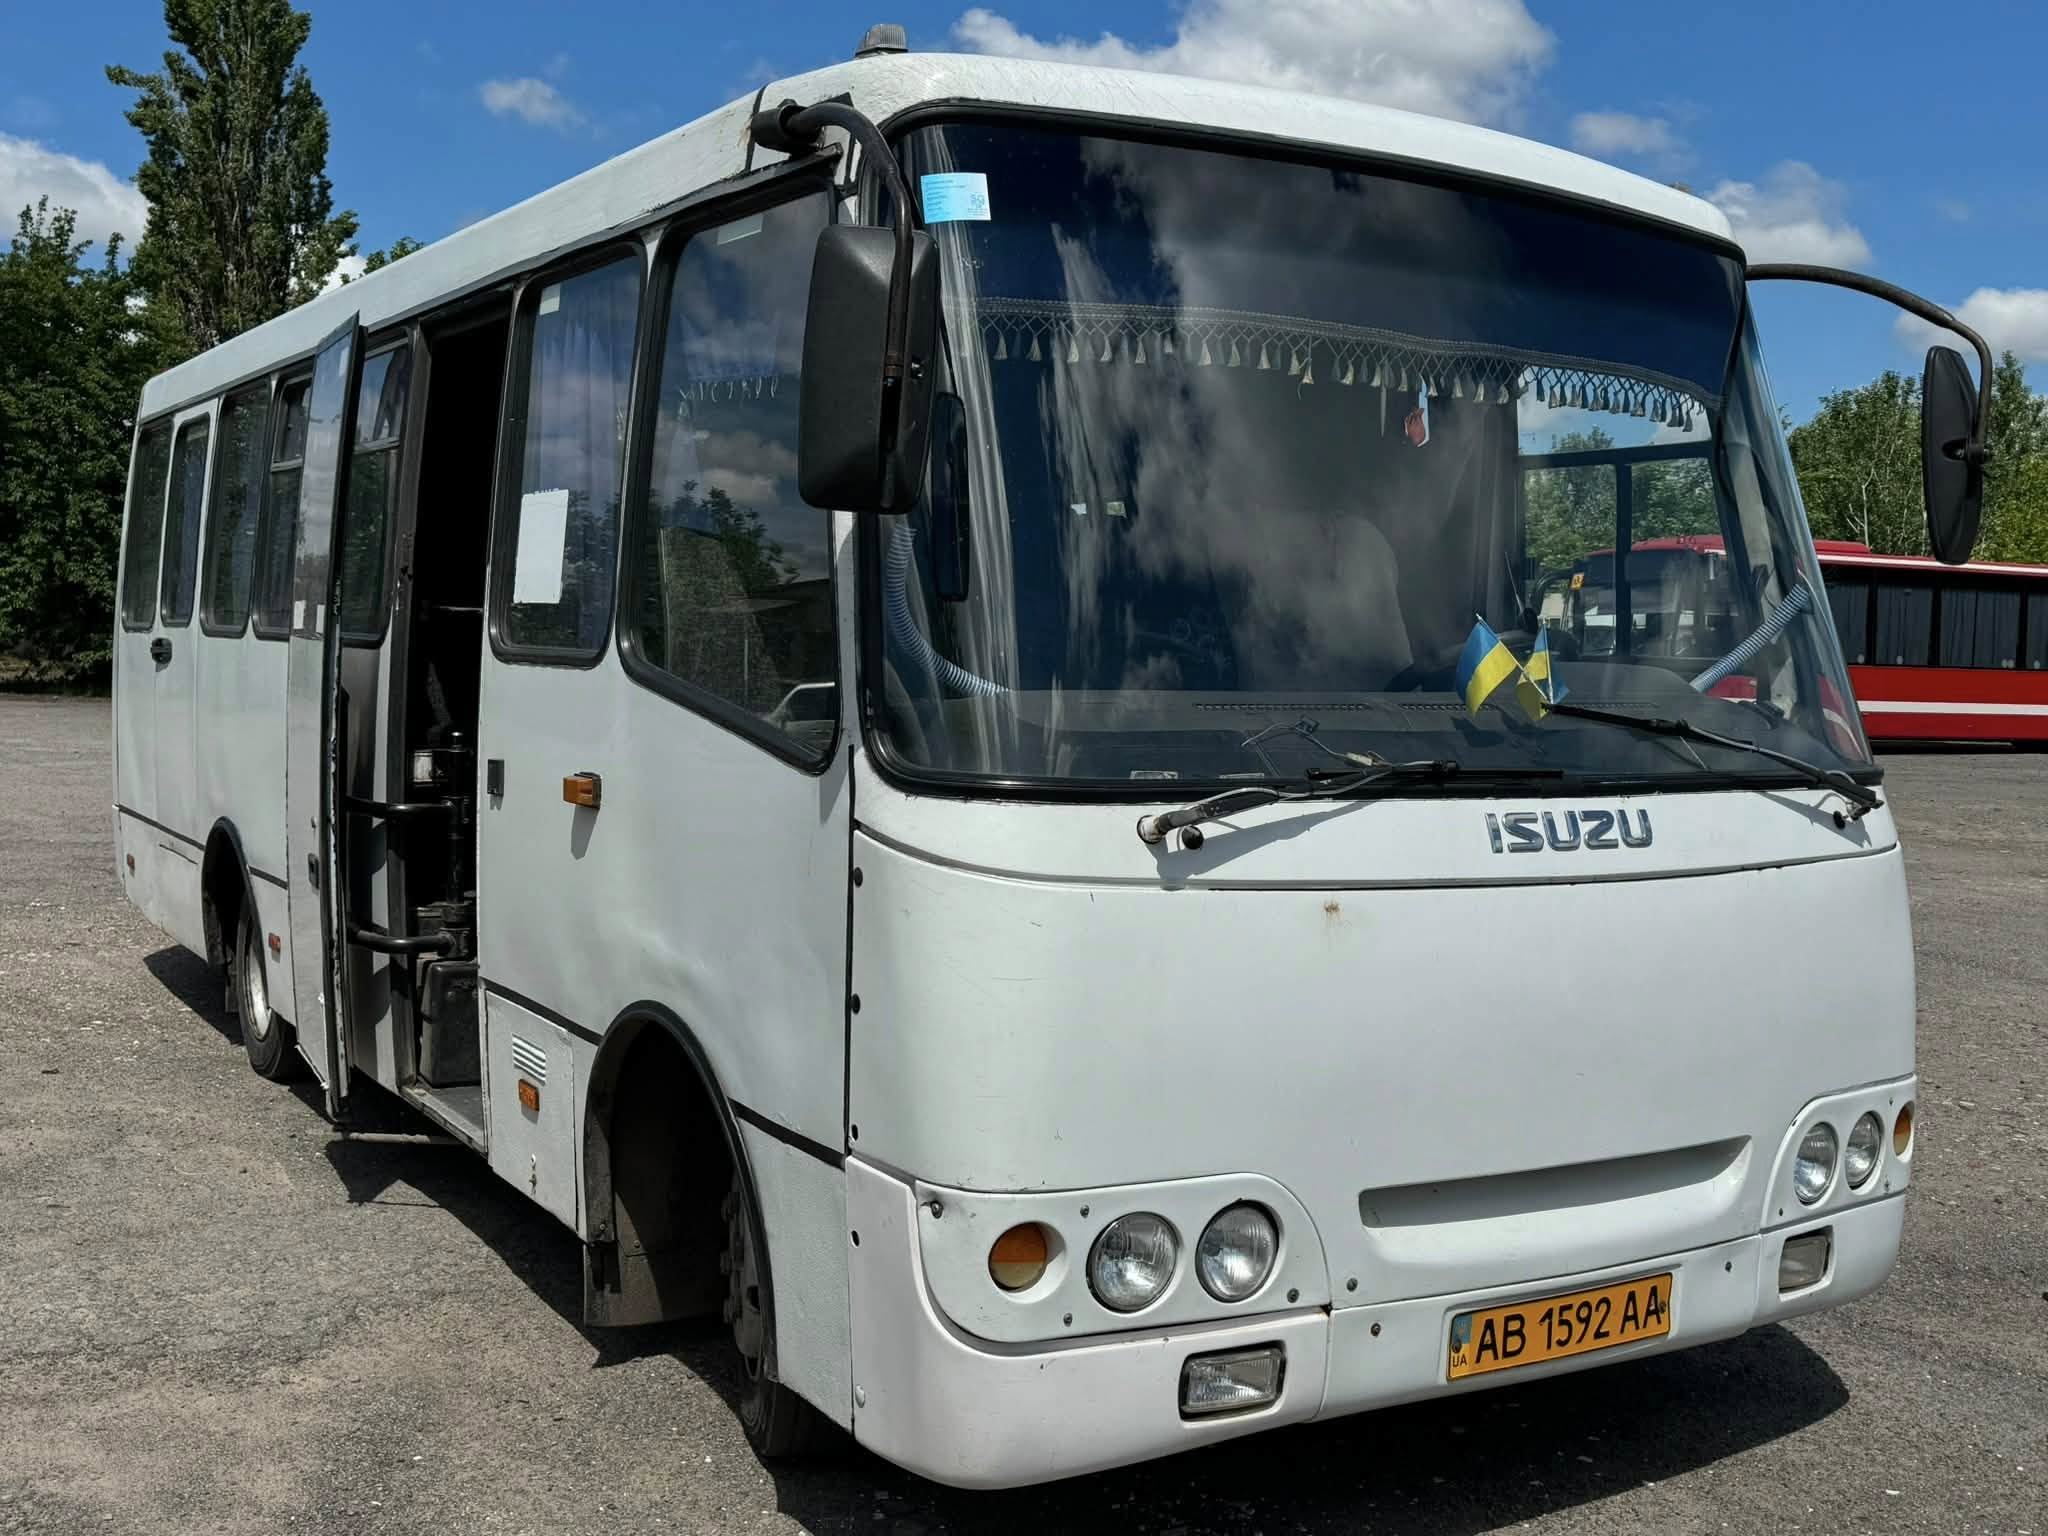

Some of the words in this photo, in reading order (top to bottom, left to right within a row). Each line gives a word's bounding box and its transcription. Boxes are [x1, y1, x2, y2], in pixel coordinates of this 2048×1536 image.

[1485, 809, 1653, 853] ISUZU
[1475, 1313, 1526, 1364] AB
[1538, 1297, 1611, 1350] 1592
[1620, 1285, 1663, 1334] AA
[1452, 1354, 1468, 1368] UA
